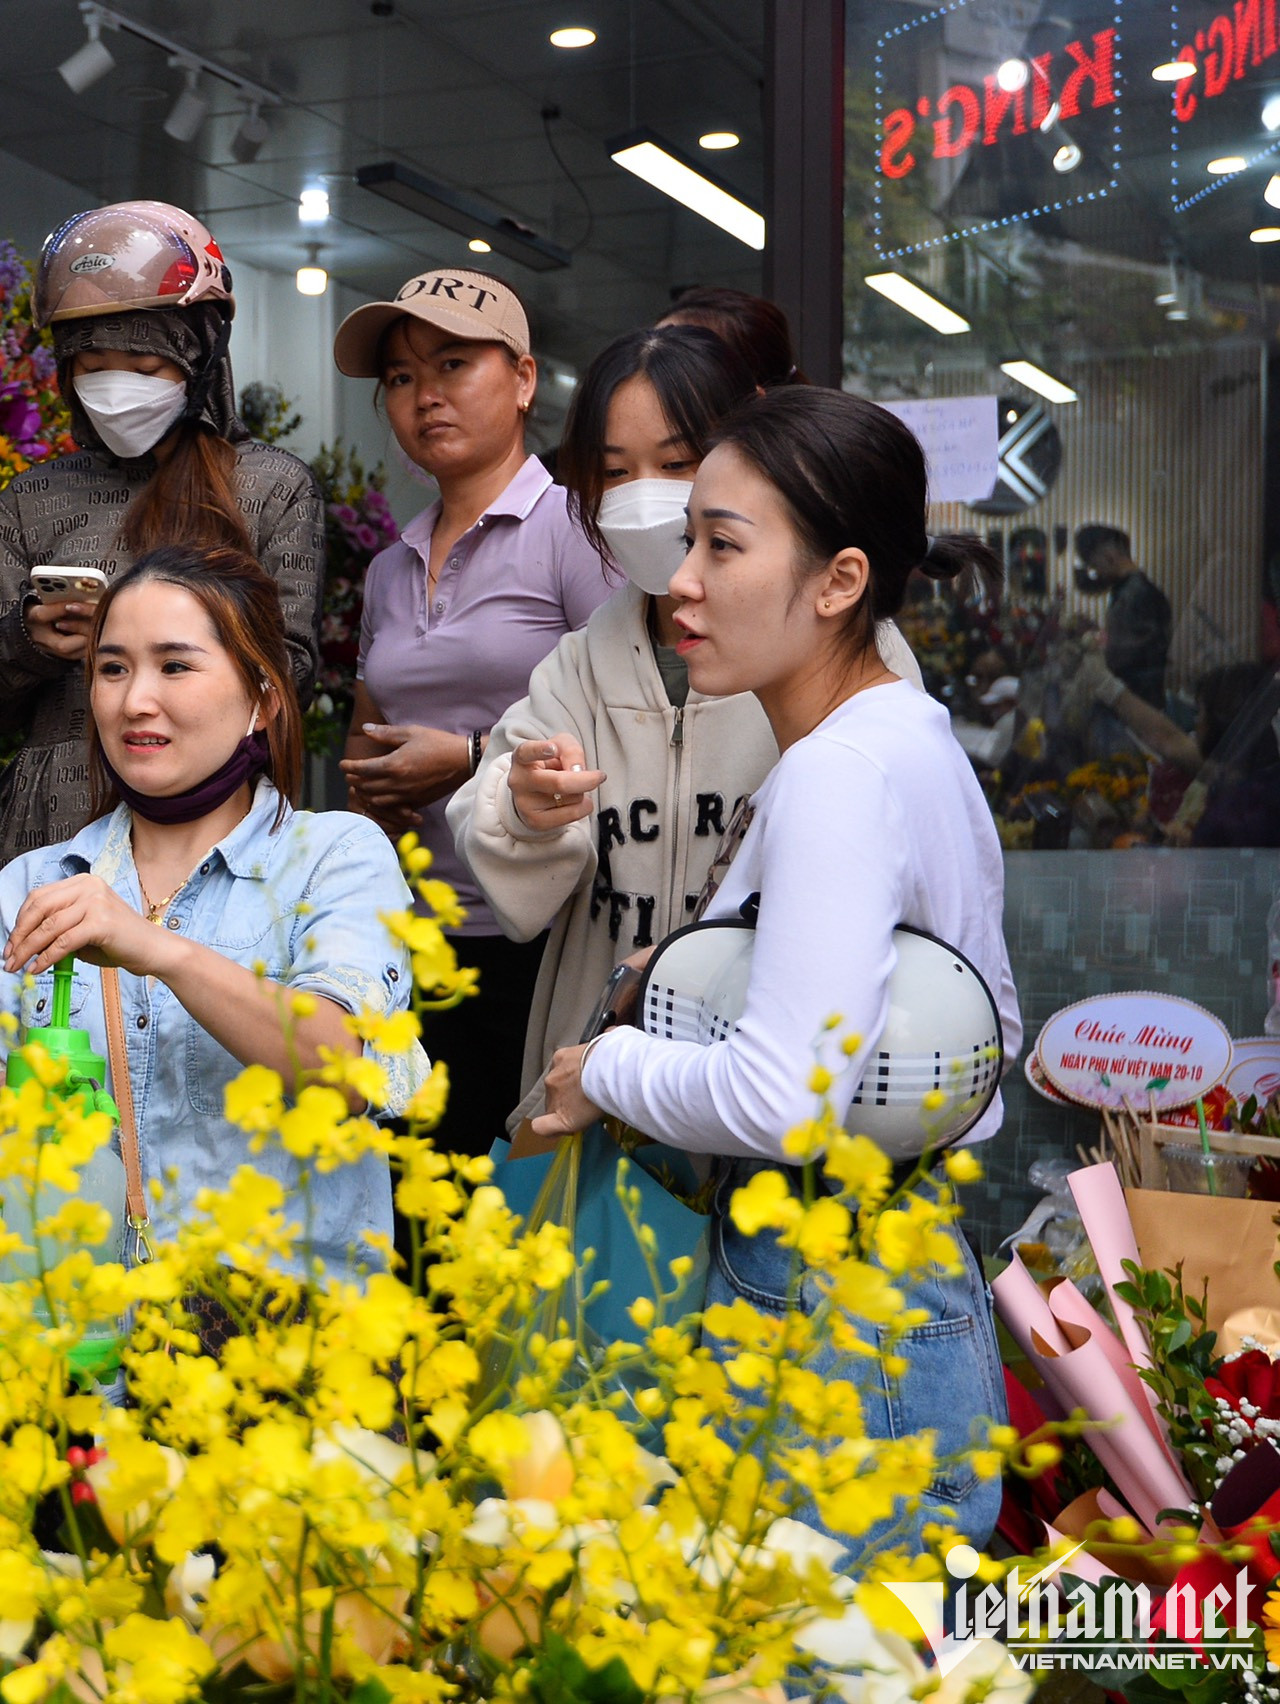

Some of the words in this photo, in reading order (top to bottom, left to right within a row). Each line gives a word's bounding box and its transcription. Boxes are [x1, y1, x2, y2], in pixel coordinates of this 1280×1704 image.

[74, 256, 109, 270] Asia
[88, 488, 130, 505] GUCCI
[53, 512, 89, 537] GUCCI
[282, 552, 316, 573] GUCCI
[57, 765, 89, 784] UCCI
[1075, 1019, 1126, 1044] Chúc
[1129, 1024, 1193, 1054] Mừng
[1060, 1051, 1087, 1070] NGÀY
[1110, 1055, 1126, 1075] NỮ
[1127, 1057, 1147, 1079] VIỆT
[1149, 1062, 1173, 1078] NAM
[1174, 1064, 1203, 1080] 20-10
